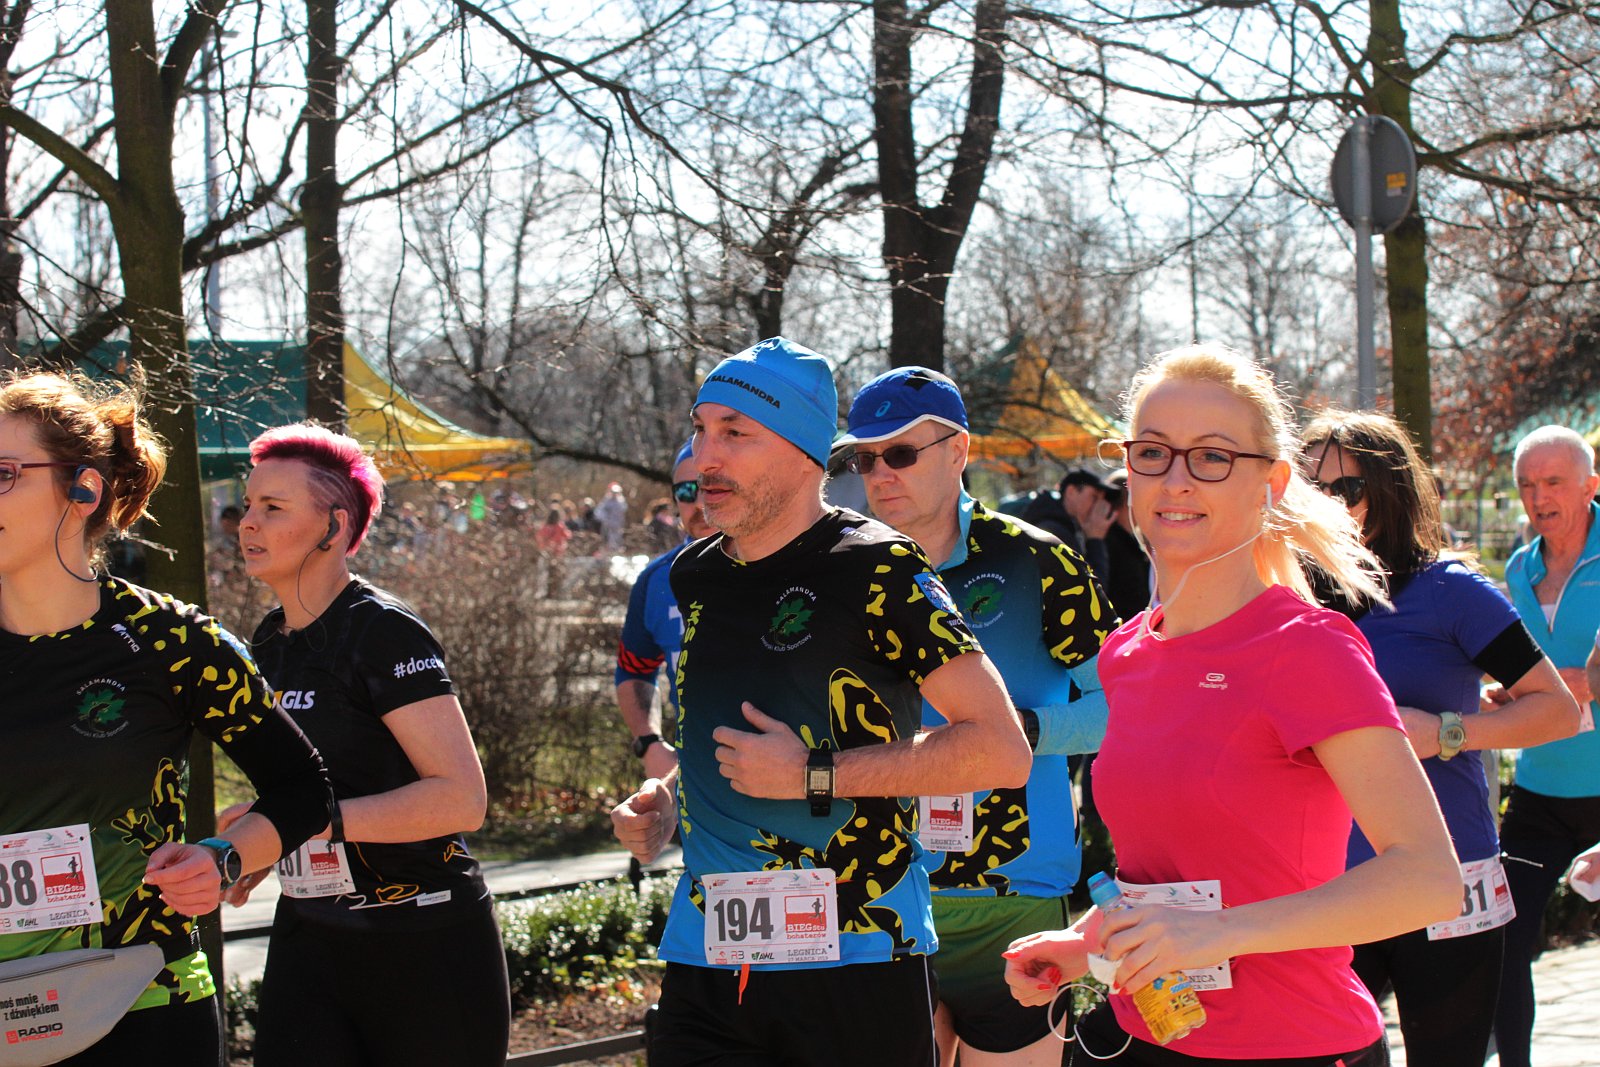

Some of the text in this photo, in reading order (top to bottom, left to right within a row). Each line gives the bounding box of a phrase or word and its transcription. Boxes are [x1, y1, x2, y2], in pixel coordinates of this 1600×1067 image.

[711, 375, 781, 409] SALAMANDRA
[281, 690, 316, 710] GLS
[49, 909, 89, 922] LEGNICA
[713, 897, 774, 942] 194
[787, 948, 828, 957] LEGNICA
[15, 993, 39, 1007] mnie
[4, 1012, 9, 1021] z
[18, 1022, 63, 1037] RADIO
